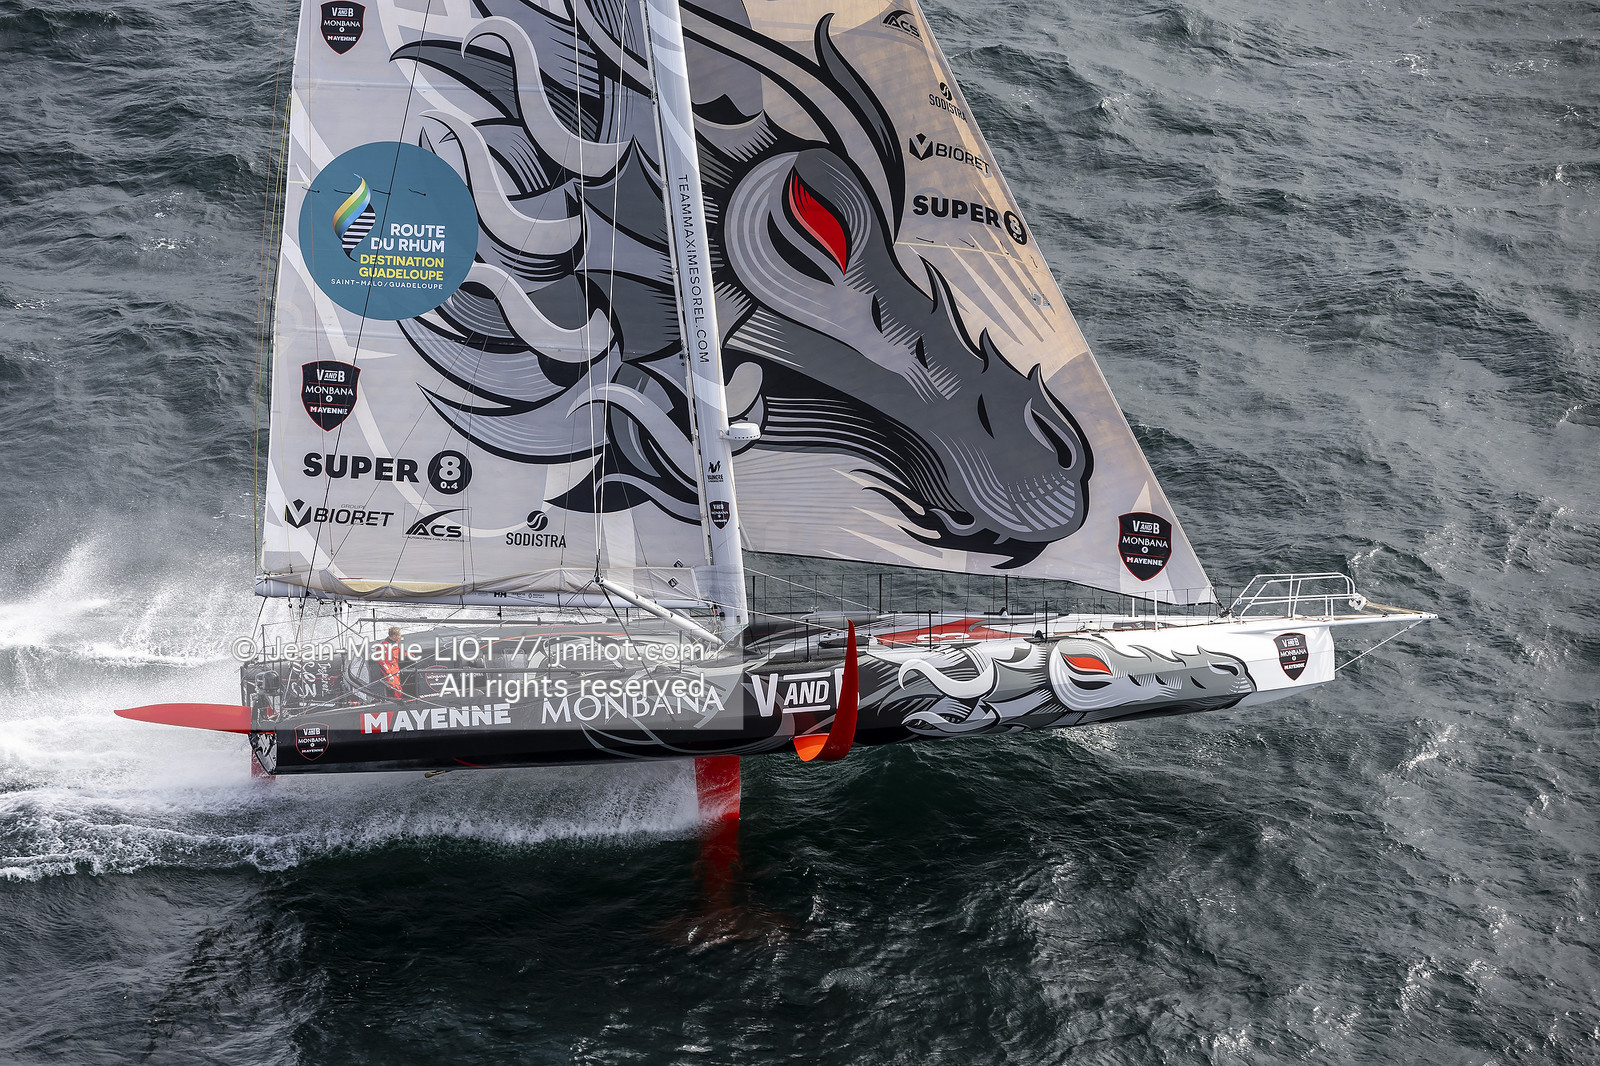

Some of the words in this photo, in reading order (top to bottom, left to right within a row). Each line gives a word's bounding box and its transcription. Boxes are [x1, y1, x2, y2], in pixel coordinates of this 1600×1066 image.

[929, 93, 968, 123] SODISTRA
[935, 143, 990, 174] BIORET
[913, 194, 1001, 229] SUPER
[390, 223, 446, 239] ROUTE
[370, 236, 395, 250] DU
[398, 239, 445, 253] RHUM
[360, 254, 445, 268] DESTINATION
[677, 173, 709, 364] TEAMMAXIMESOREL.COM
[358, 266, 444, 281] GUADELOUPE
[305, 385, 354, 396] MONBANA
[310, 406, 348, 415] MAYENNE
[302, 452, 419, 483] SUPER
[439, 455, 461, 481] 8
[313, 507, 394, 527] BIORET
[405, 523, 462, 538] ACS
[505, 532, 567, 548] SODISTRA
[1122, 535, 1168, 548] MONBANA
[1126, 556, 1163, 566] MAYENNE
[1280, 648, 1307, 657] MONBANA
[751, 674, 779, 717] V
[784, 680, 829, 704] AND
[541, 685, 724, 724] MONBANA
[361, 703, 511, 734] MAYENNE
